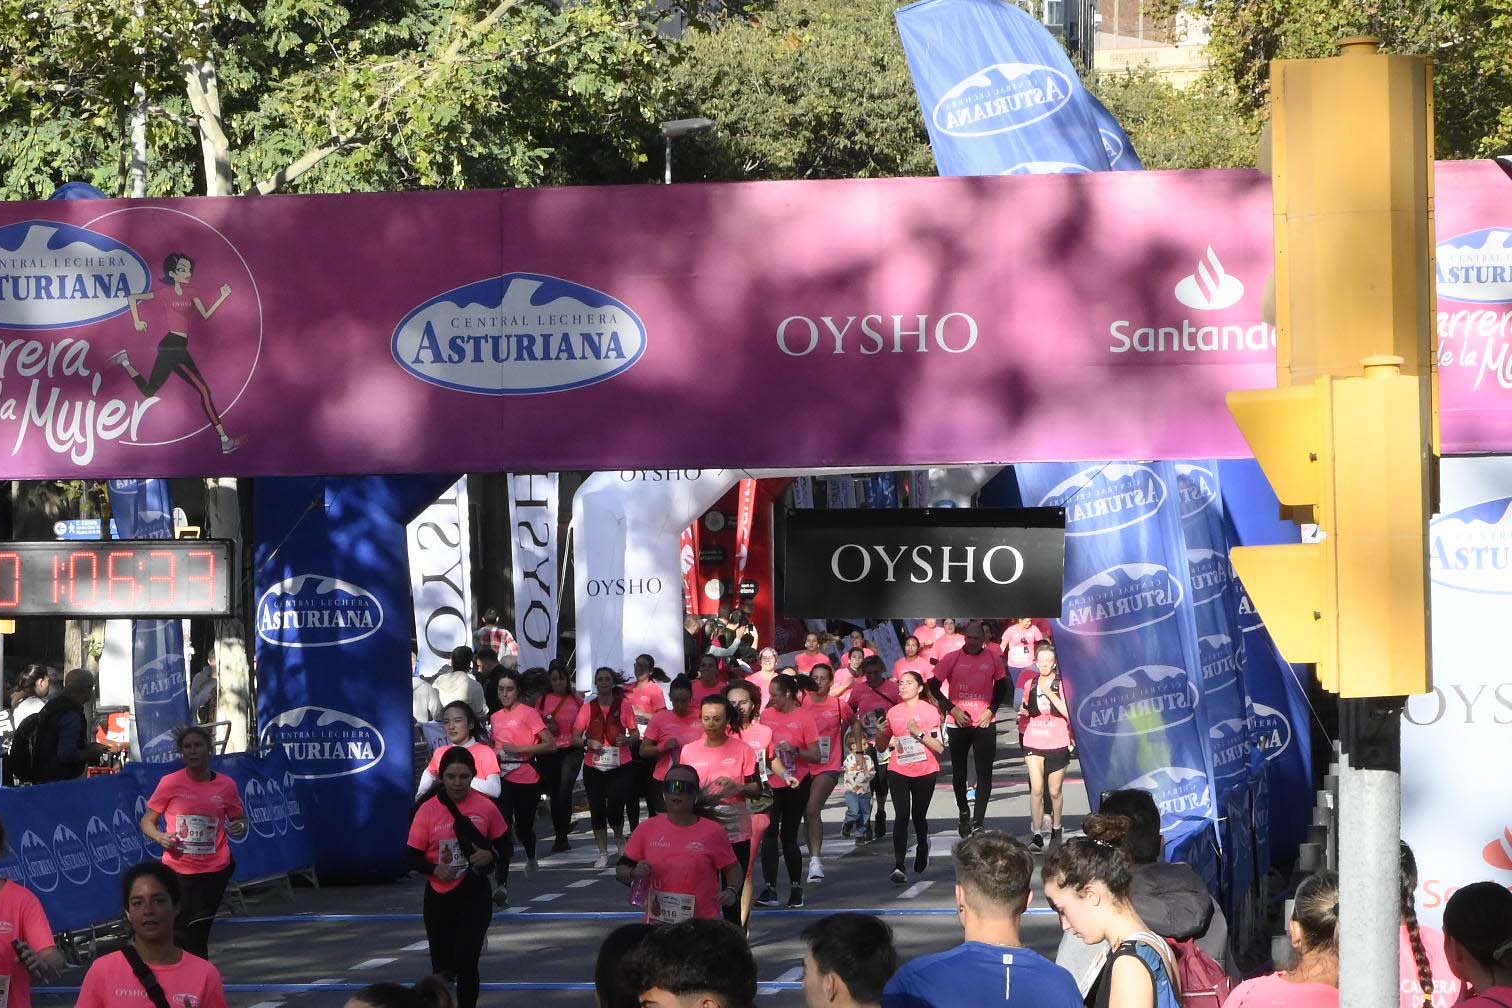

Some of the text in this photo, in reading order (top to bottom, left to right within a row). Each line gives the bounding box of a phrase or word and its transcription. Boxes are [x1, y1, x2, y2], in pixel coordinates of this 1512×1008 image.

[54, 256, 126, 268] LECHERA
[450, 313, 618, 328] CENTRAL LECHERA
[776, 312, 978, 356] OYSHO
[412, 321, 628, 367] ASTURIANA
[12, 373, 162, 466] Mujer
[830, 543, 1024, 584] OYSHO
[587, 577, 662, 596] OYSHO
[262, 604, 374, 631] ASTURIANA
